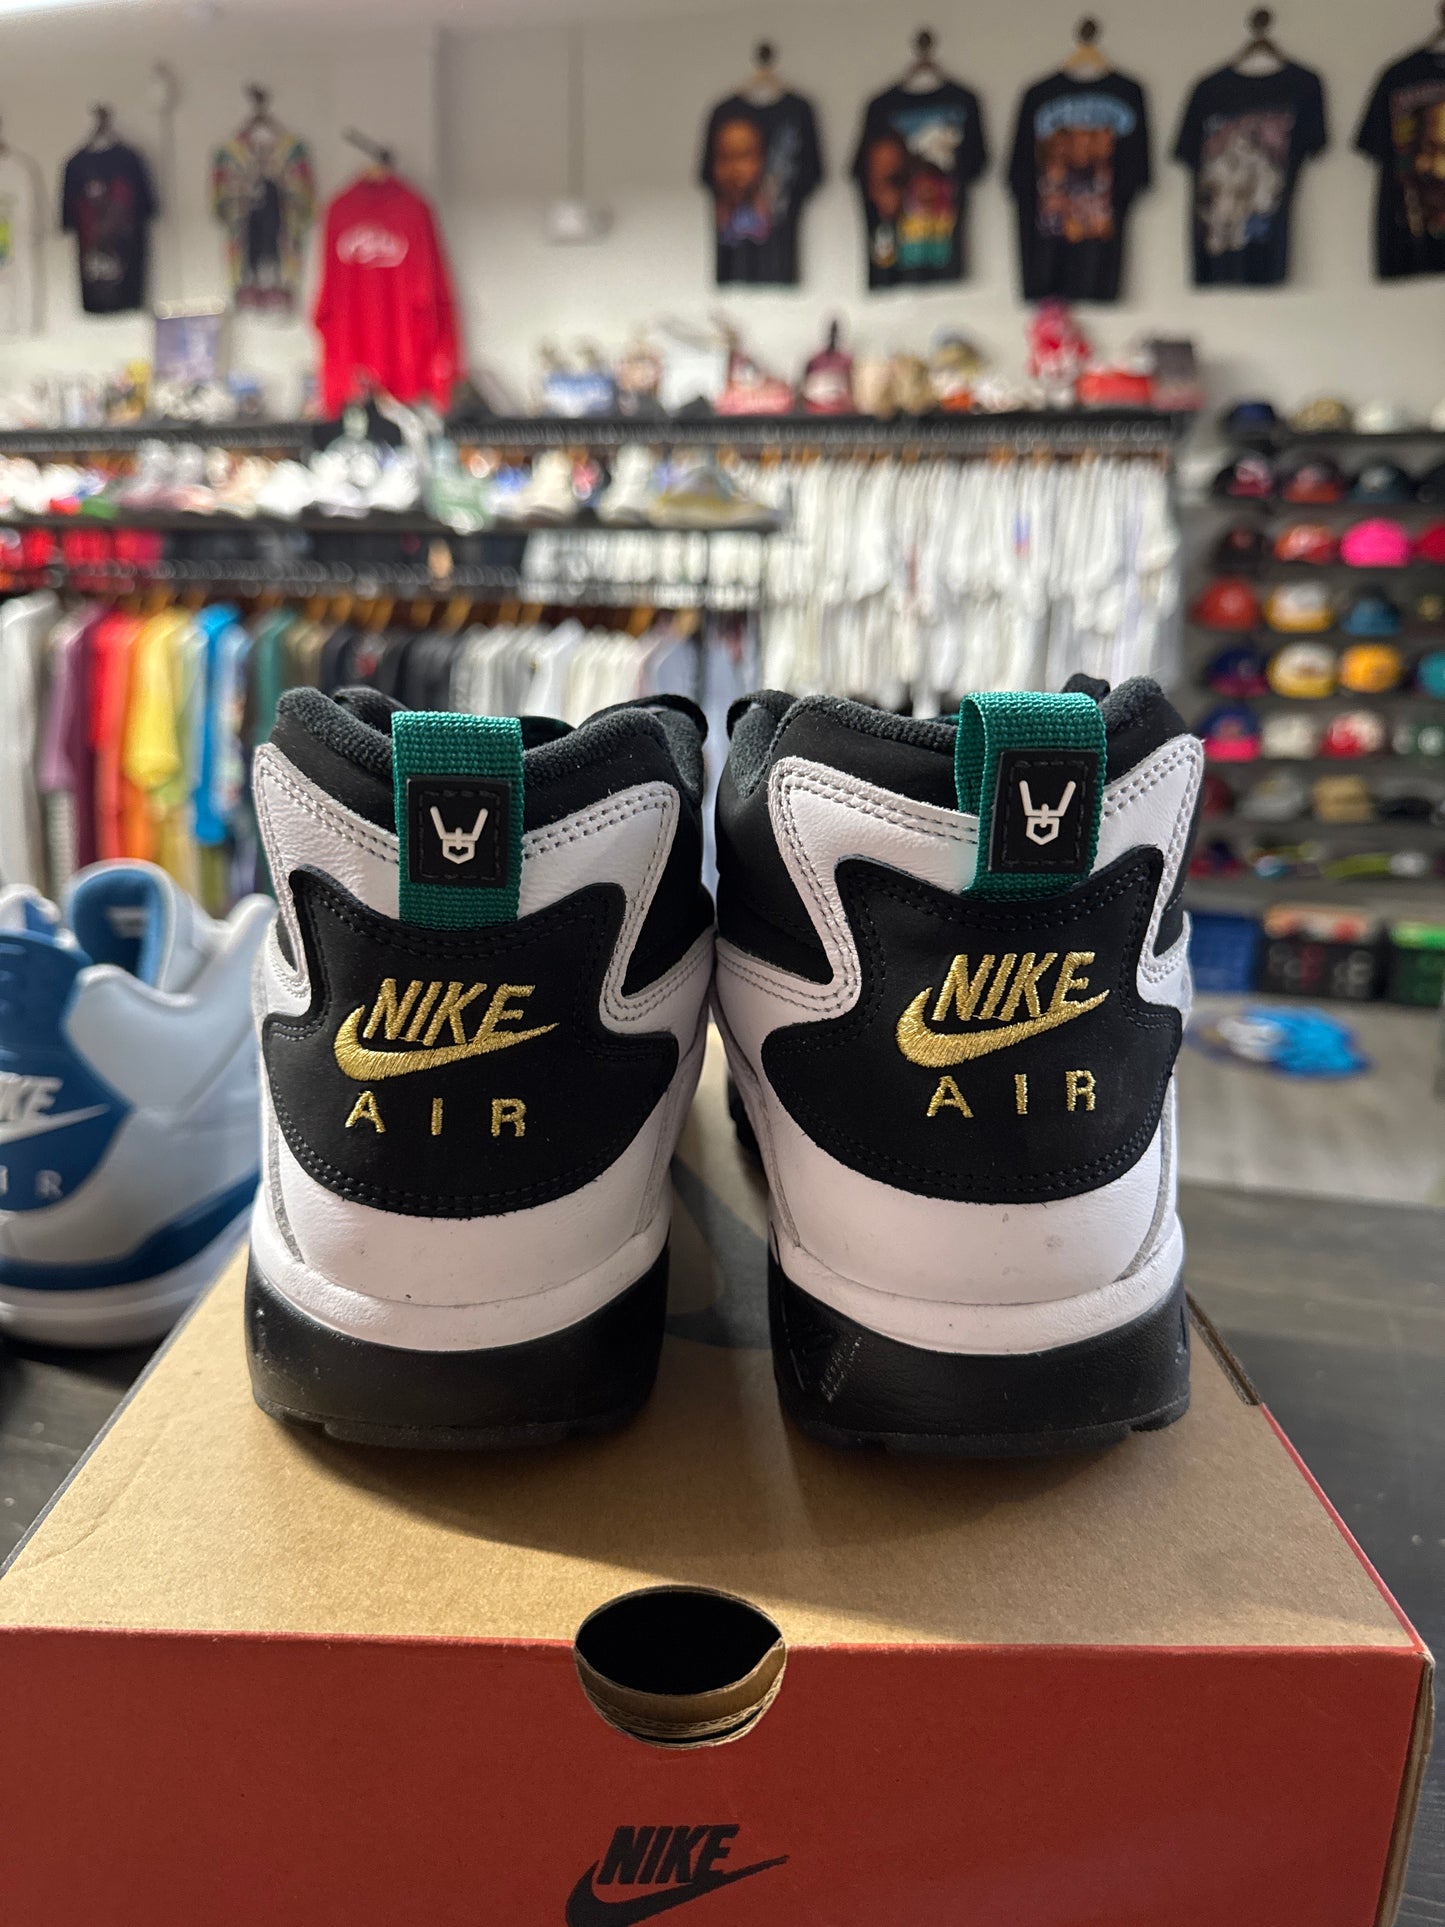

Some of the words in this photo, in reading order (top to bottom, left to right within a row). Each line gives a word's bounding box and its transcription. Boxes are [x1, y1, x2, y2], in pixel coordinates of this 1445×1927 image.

[363, 977, 535, 1047] NIKE
[931, 951, 1095, 1022] NIKE
[597, 1823, 741, 1885] NIKE
